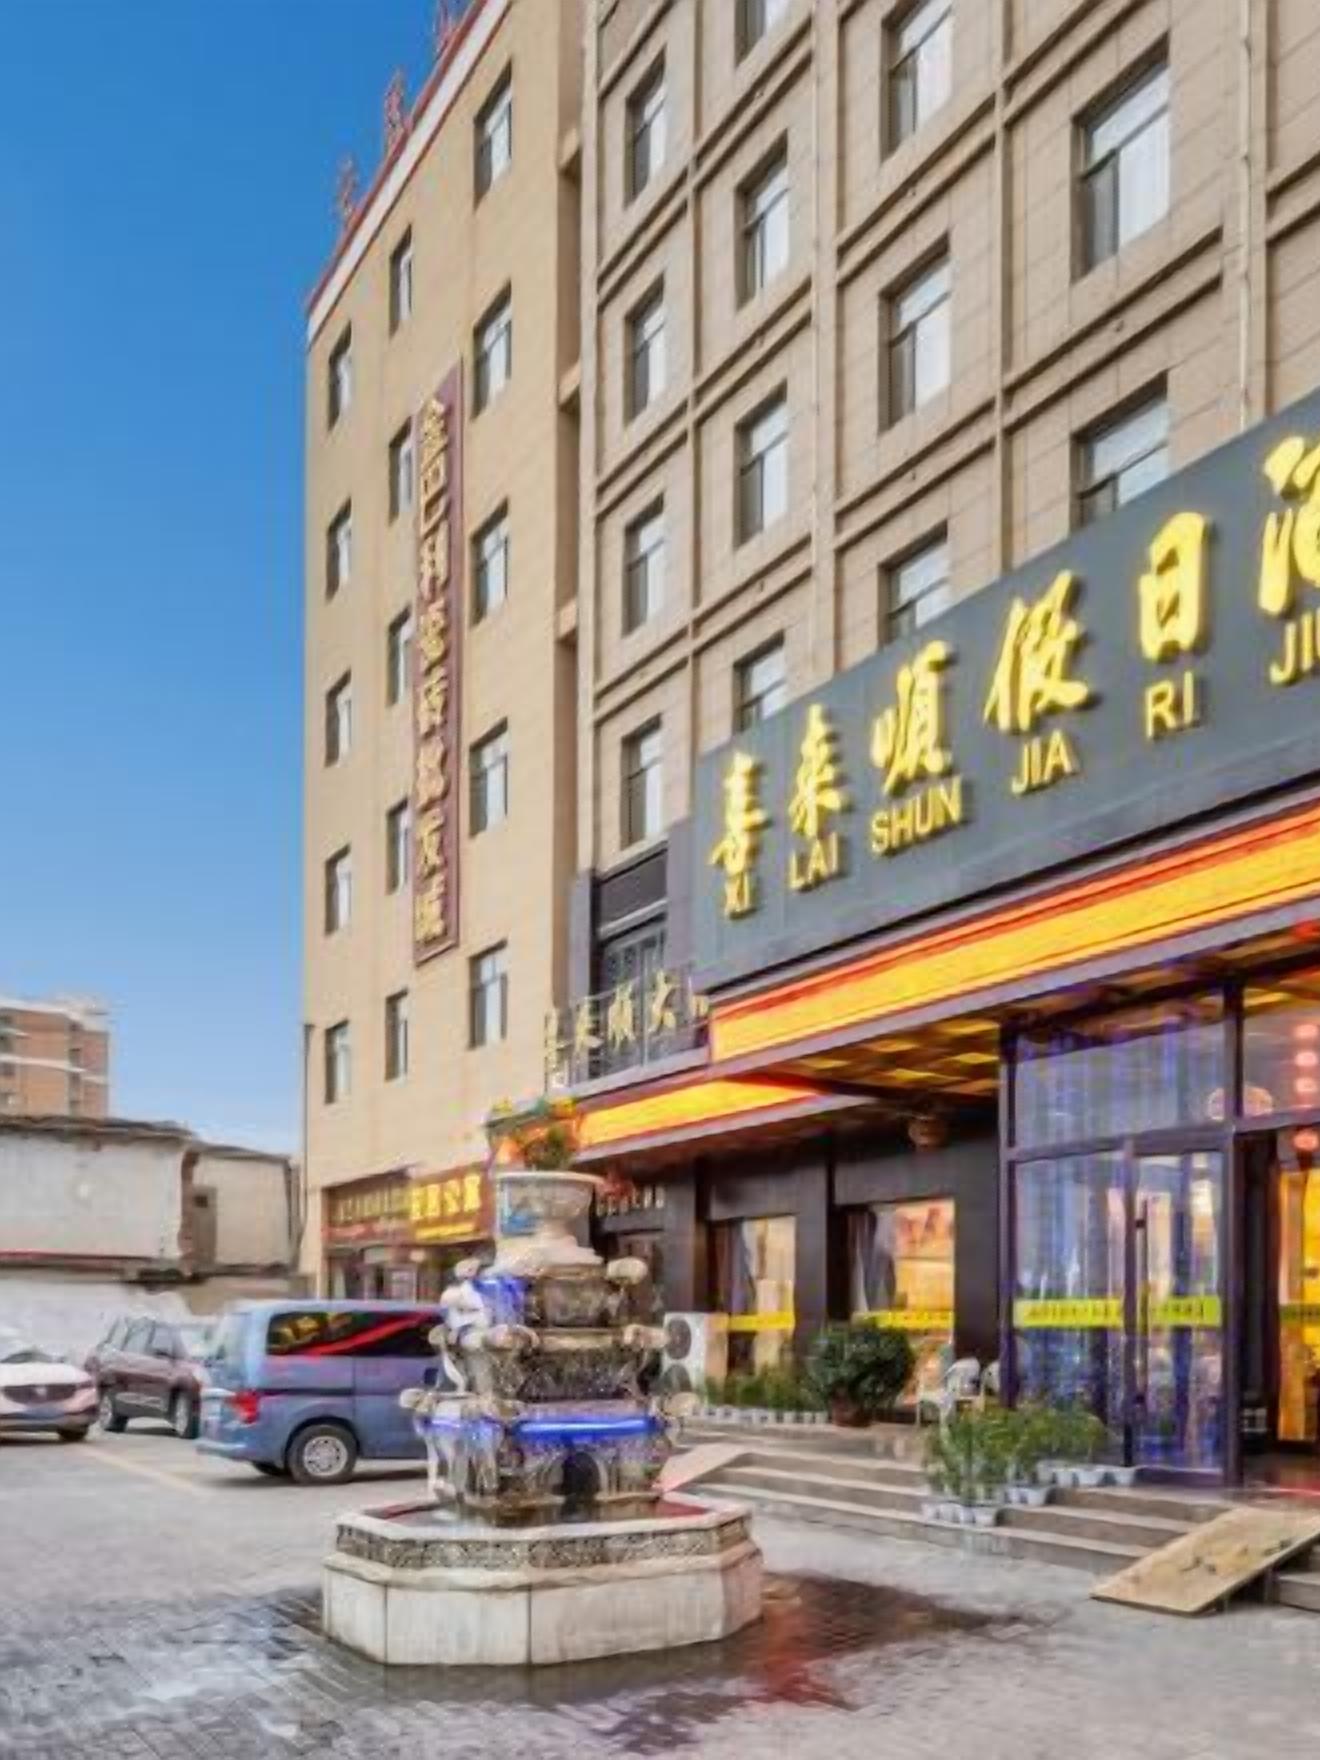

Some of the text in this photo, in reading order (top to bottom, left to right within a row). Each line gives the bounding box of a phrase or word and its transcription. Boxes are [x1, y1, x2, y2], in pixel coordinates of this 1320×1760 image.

[788, 833, 840, 891] LAI
[871, 775, 963, 855] SHUN
[1011, 728, 1078, 795] JIA
[1145, 670, 1196, 739] RI
